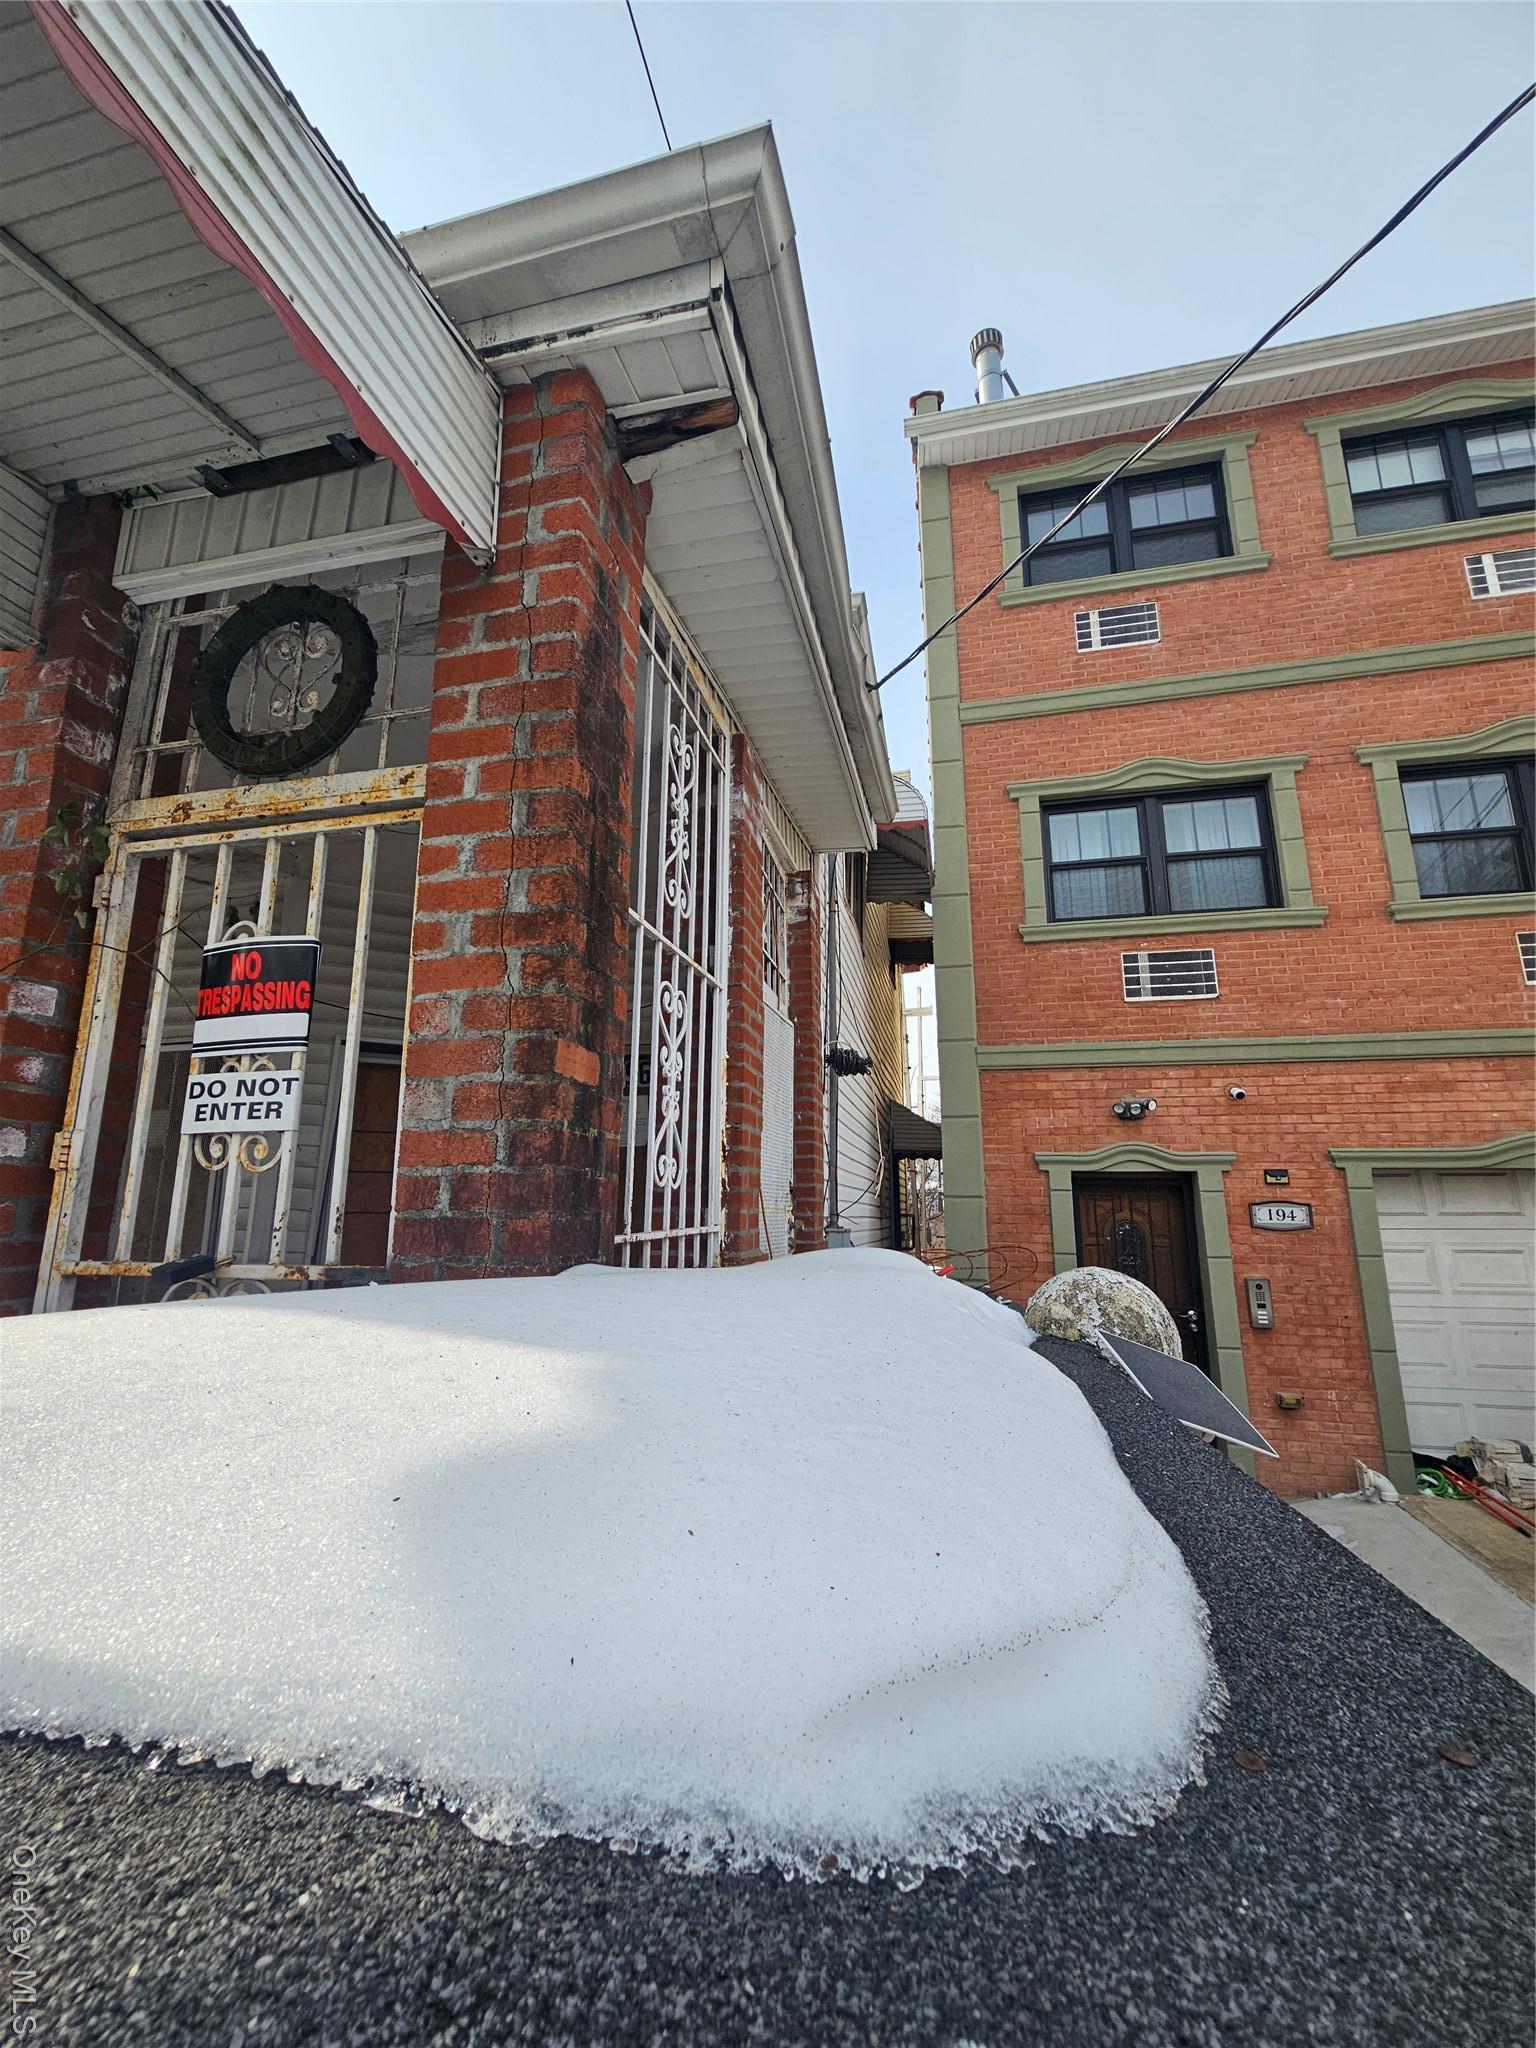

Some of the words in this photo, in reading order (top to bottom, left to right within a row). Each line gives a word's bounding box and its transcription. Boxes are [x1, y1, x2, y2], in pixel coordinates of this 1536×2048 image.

[231, 950, 262, 982] NO
[197, 980, 311, 1017] TRESPASSING
[188, 1080, 227, 1100] DO
[235, 1077, 300, 1097] NOT
[194, 1100, 284, 1122] ENTER
[1267, 1208, 1297, 1221] 194
